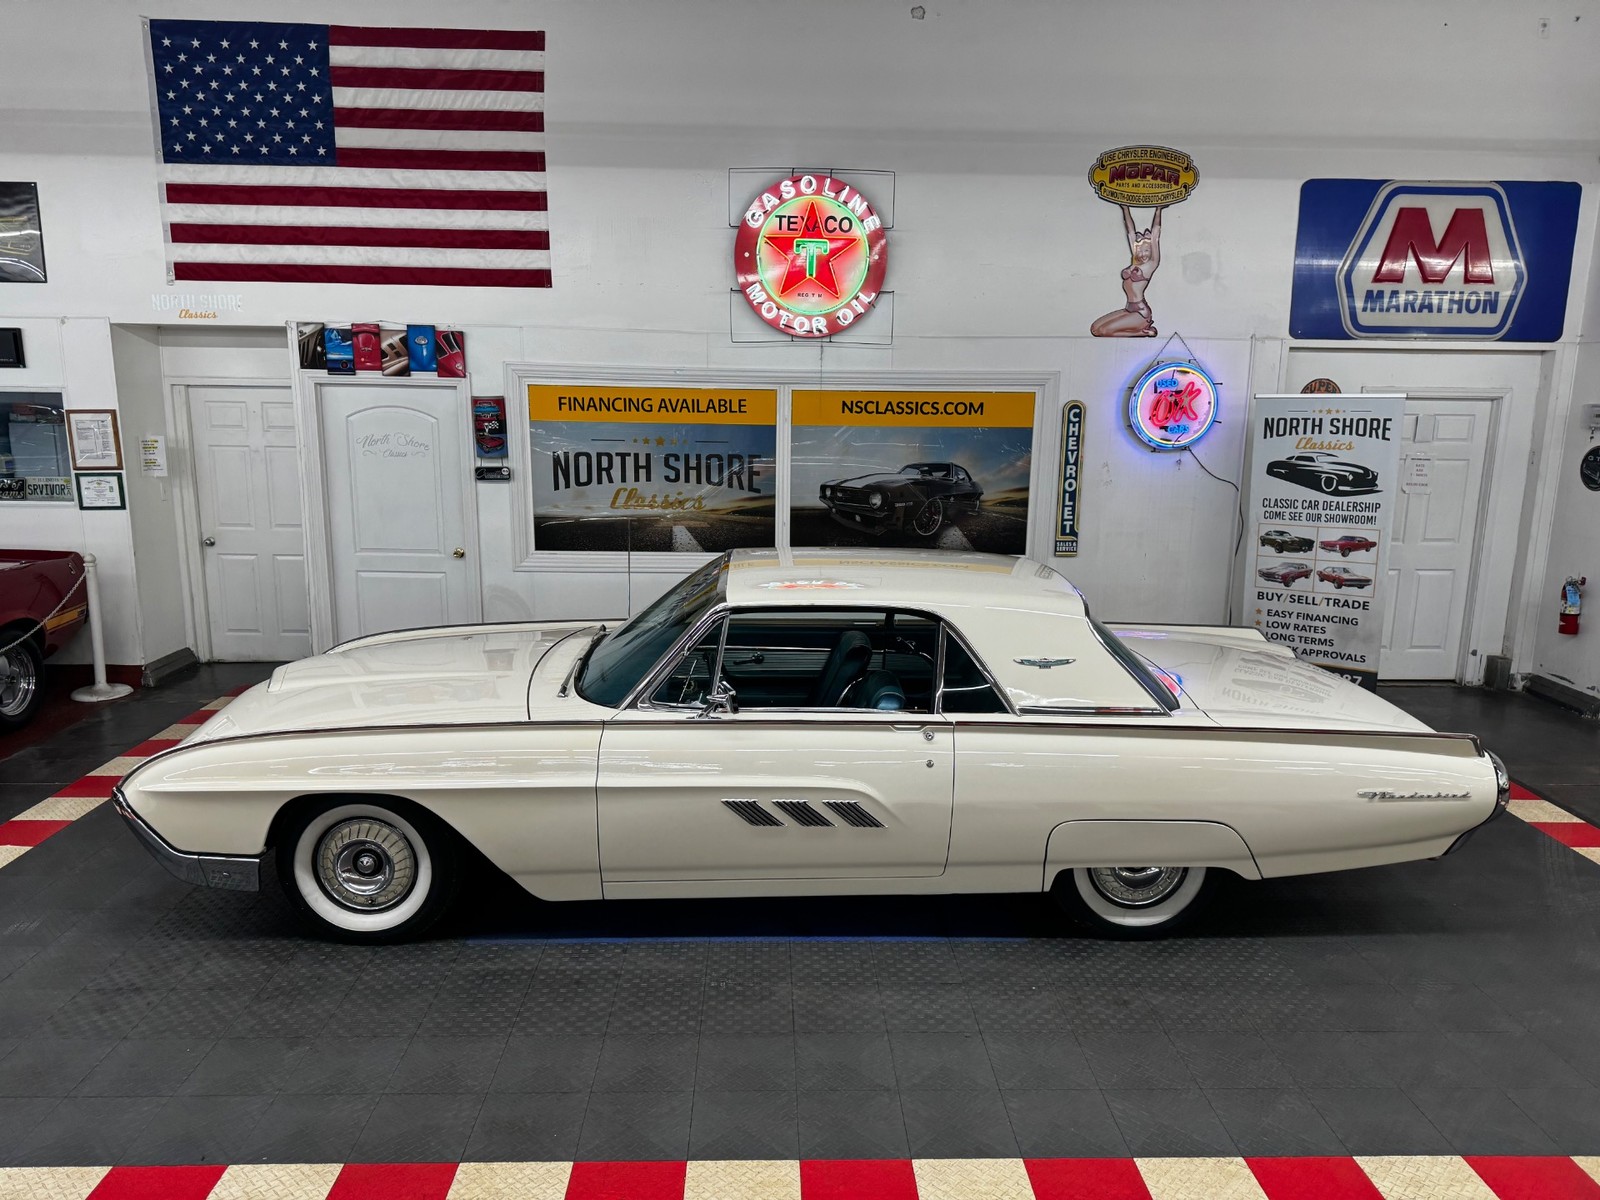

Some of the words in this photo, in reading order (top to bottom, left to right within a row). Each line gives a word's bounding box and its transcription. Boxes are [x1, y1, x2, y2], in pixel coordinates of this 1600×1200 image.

[1104, 153, 1117, 163] USE
[1117, 149, 1148, 160] CHRYSLER
[1149, 150, 1186, 165] ENGINEERED
[745, 175, 881, 234] GASOLINE
[775, 214, 853, 234] TEXACO
[1371, 207, 1495, 284] M
[794, 238, 829, 278] T
[152, 294, 195, 311] NORTH
[200, 294, 244, 313] SHORE
[746, 282, 828, 335] MOTOR
[836, 291, 876, 326] OIL
[1362, 289, 1500, 315] MARATHON
[178, 308, 218, 319] Classics
[1156, 379, 1178, 388] USED
[558, 396, 653, 413] FINANCING
[657, 398, 747, 414] AVAILABLE
[841, 400, 984, 416] NSCLASSICS.COM
[1168, 425, 1190, 434] CARS
[1263, 417, 1323, 439] NORTH
[1329, 417, 1392, 441] SHORE
[356, 432, 391, 448] North
[394, 432, 430, 451] Shore
[1295, 437, 1355, 450] Classics
[553, 451, 652, 492] NORTH
[664, 453, 762, 494] SHORE
[1064, 408, 1080, 534] CHEVROLET
[27, 483, 65, 496] SRVIVOR
[609, 487, 706, 511] Classics
[1262, 498, 1299, 510] CLASSIC
[1301, 500, 1320, 511] CAR
[1322, 500, 1381, 513] DEALERSHIP
[1263, 511, 1286, 521] COME
[1288, 512, 1303, 522] SEE
[1305, 512, 1322, 523] OUR
[1324, 513, 1377, 525] SHOWROOM!
[1257, 591, 1370, 611] BUY/SELL/TRADE
[1267, 609, 1294, 619] EASY
[1296, 613, 1359, 626] FINANCING
[1266, 620, 1292, 631] LOW
[1294, 623, 1326, 634] RATES
[1265, 632, 1295, 643] LONG
[1298, 635, 1334, 647] TERMS
[1301, 648, 1366, 663] APPROVALS
